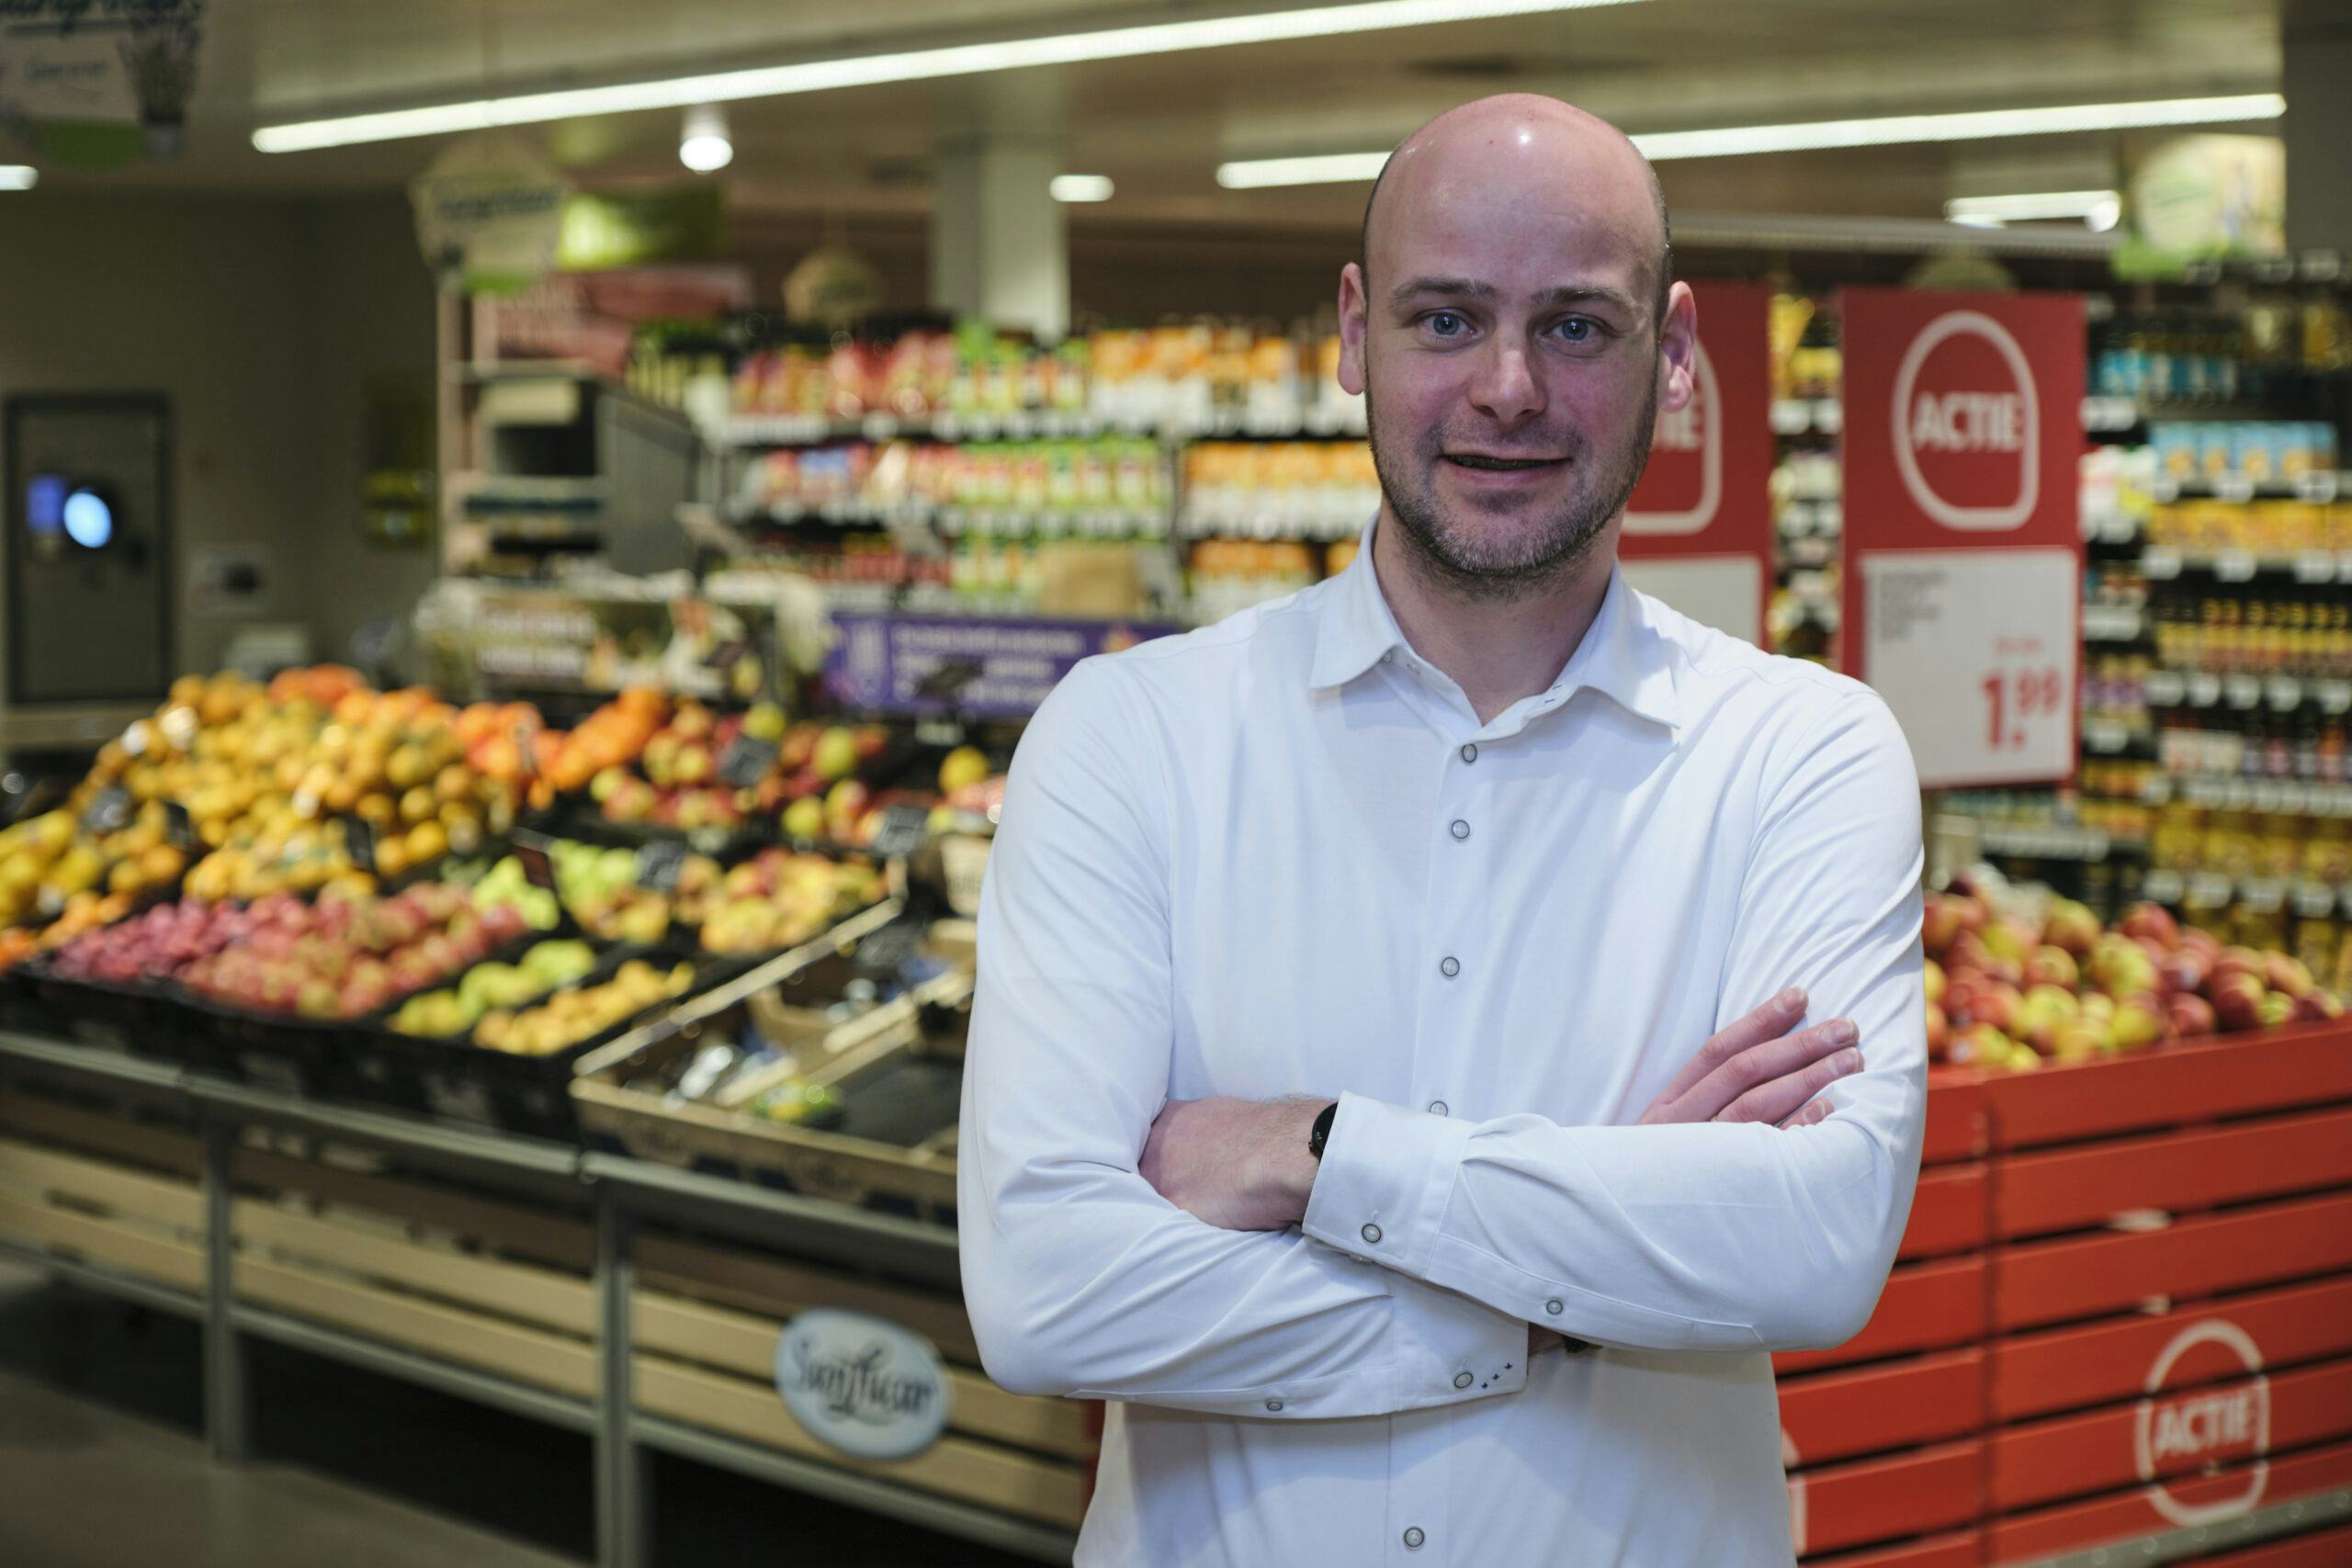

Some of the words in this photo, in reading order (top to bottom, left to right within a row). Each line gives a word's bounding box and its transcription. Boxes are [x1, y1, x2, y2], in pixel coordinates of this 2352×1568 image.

[1912, 392, 2023, 451] ACTIE
[1980, 669, 2061, 749] 1.99
[2154, 1390, 2258, 1457] ACTIE
